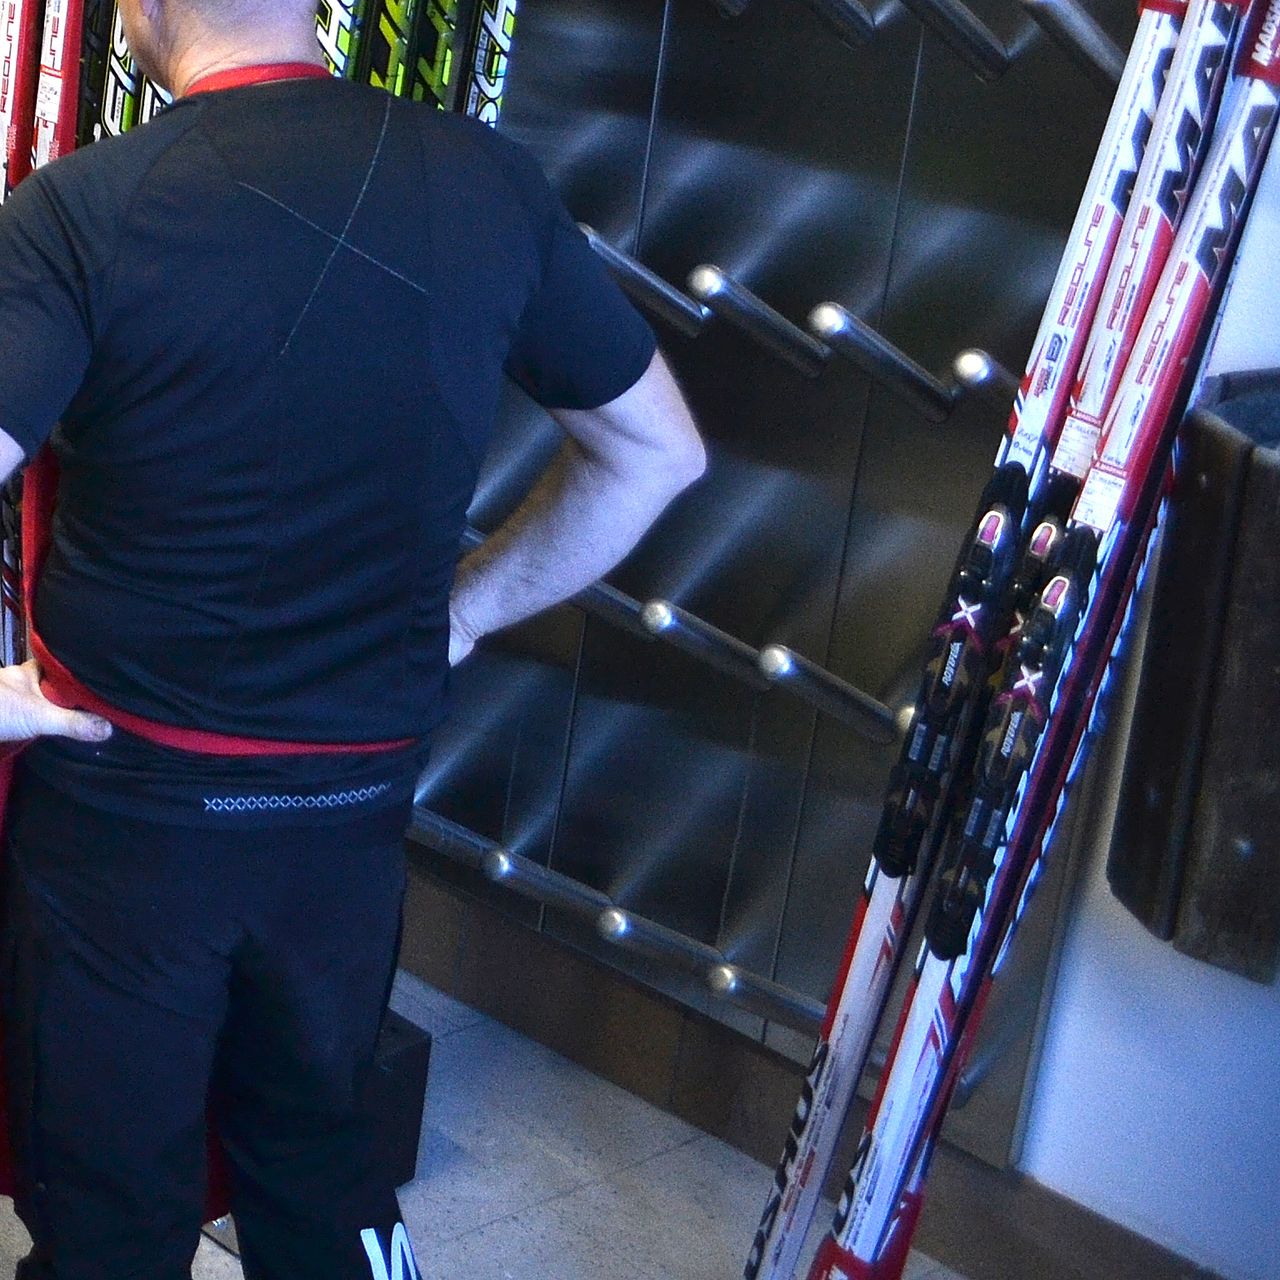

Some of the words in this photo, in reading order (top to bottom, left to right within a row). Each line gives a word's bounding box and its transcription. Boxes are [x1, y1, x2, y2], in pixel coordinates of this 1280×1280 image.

[1057, 203, 1105, 327] REDLINE
[1106, 204, 1152, 331] REDLINE
[1135, 260, 1189, 385] REDLINE
